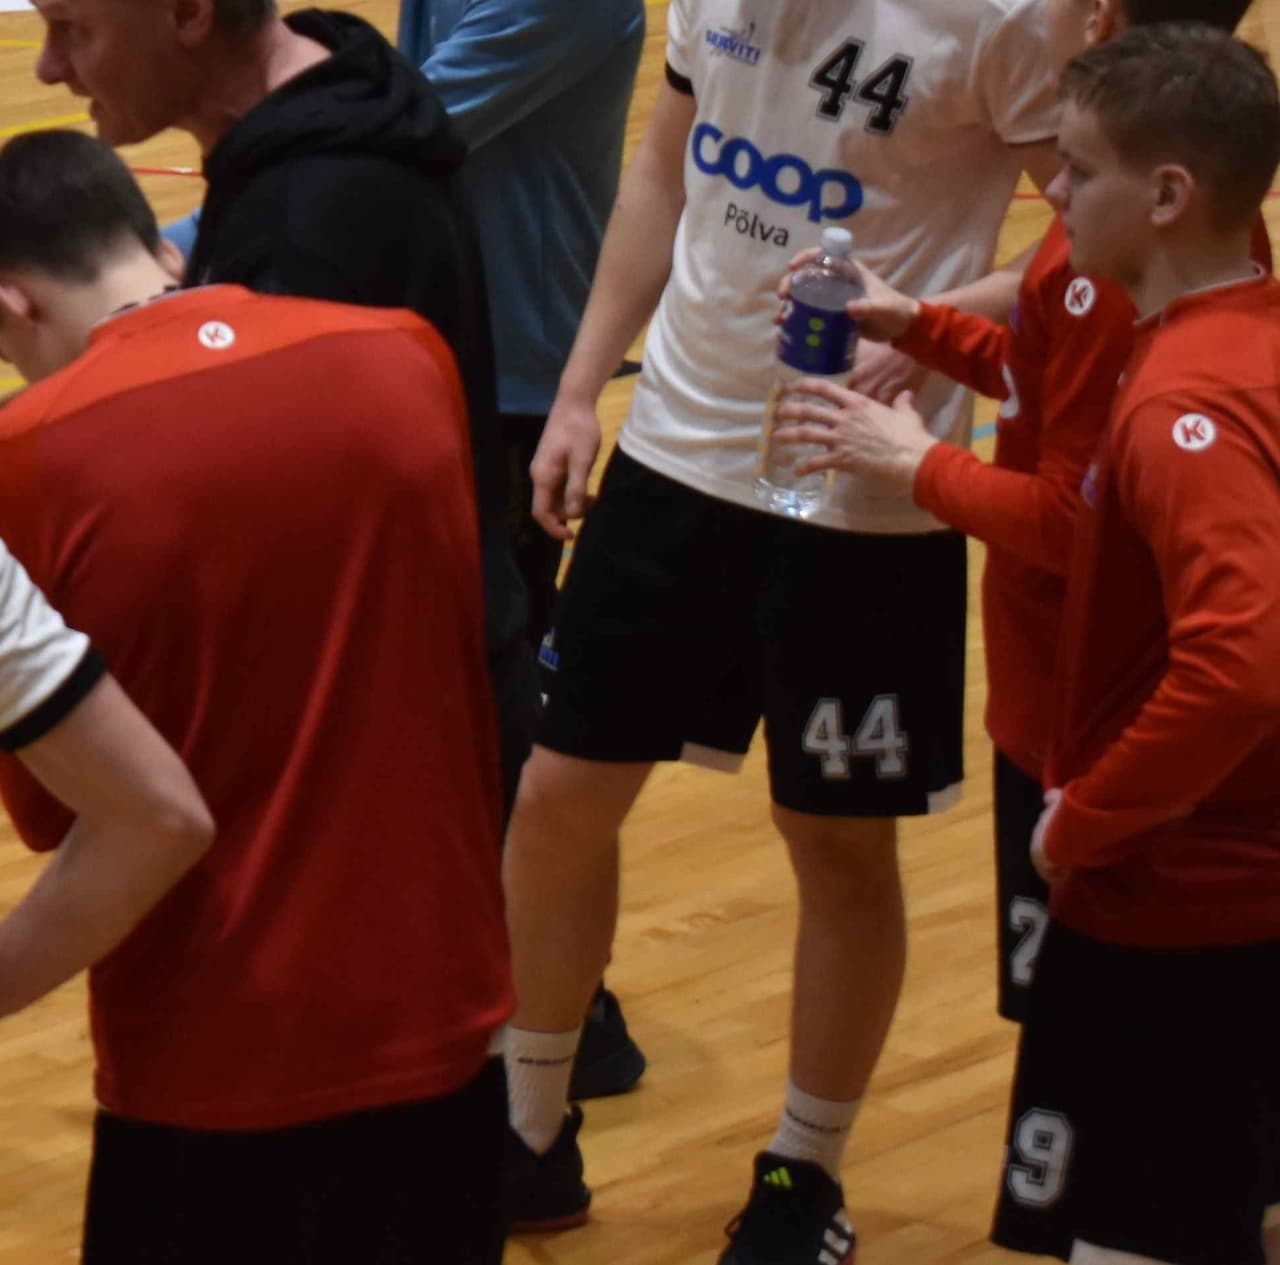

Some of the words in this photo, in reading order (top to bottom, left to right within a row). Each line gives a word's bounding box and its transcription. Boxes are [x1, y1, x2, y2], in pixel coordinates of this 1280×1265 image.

[808, 35, 914, 135] 44
[692, 122, 865, 224] coop
[724, 202, 790, 248] Põlva
[800, 692, 910, 782] 44
[1007, 1106, 1074, 1208] 9
